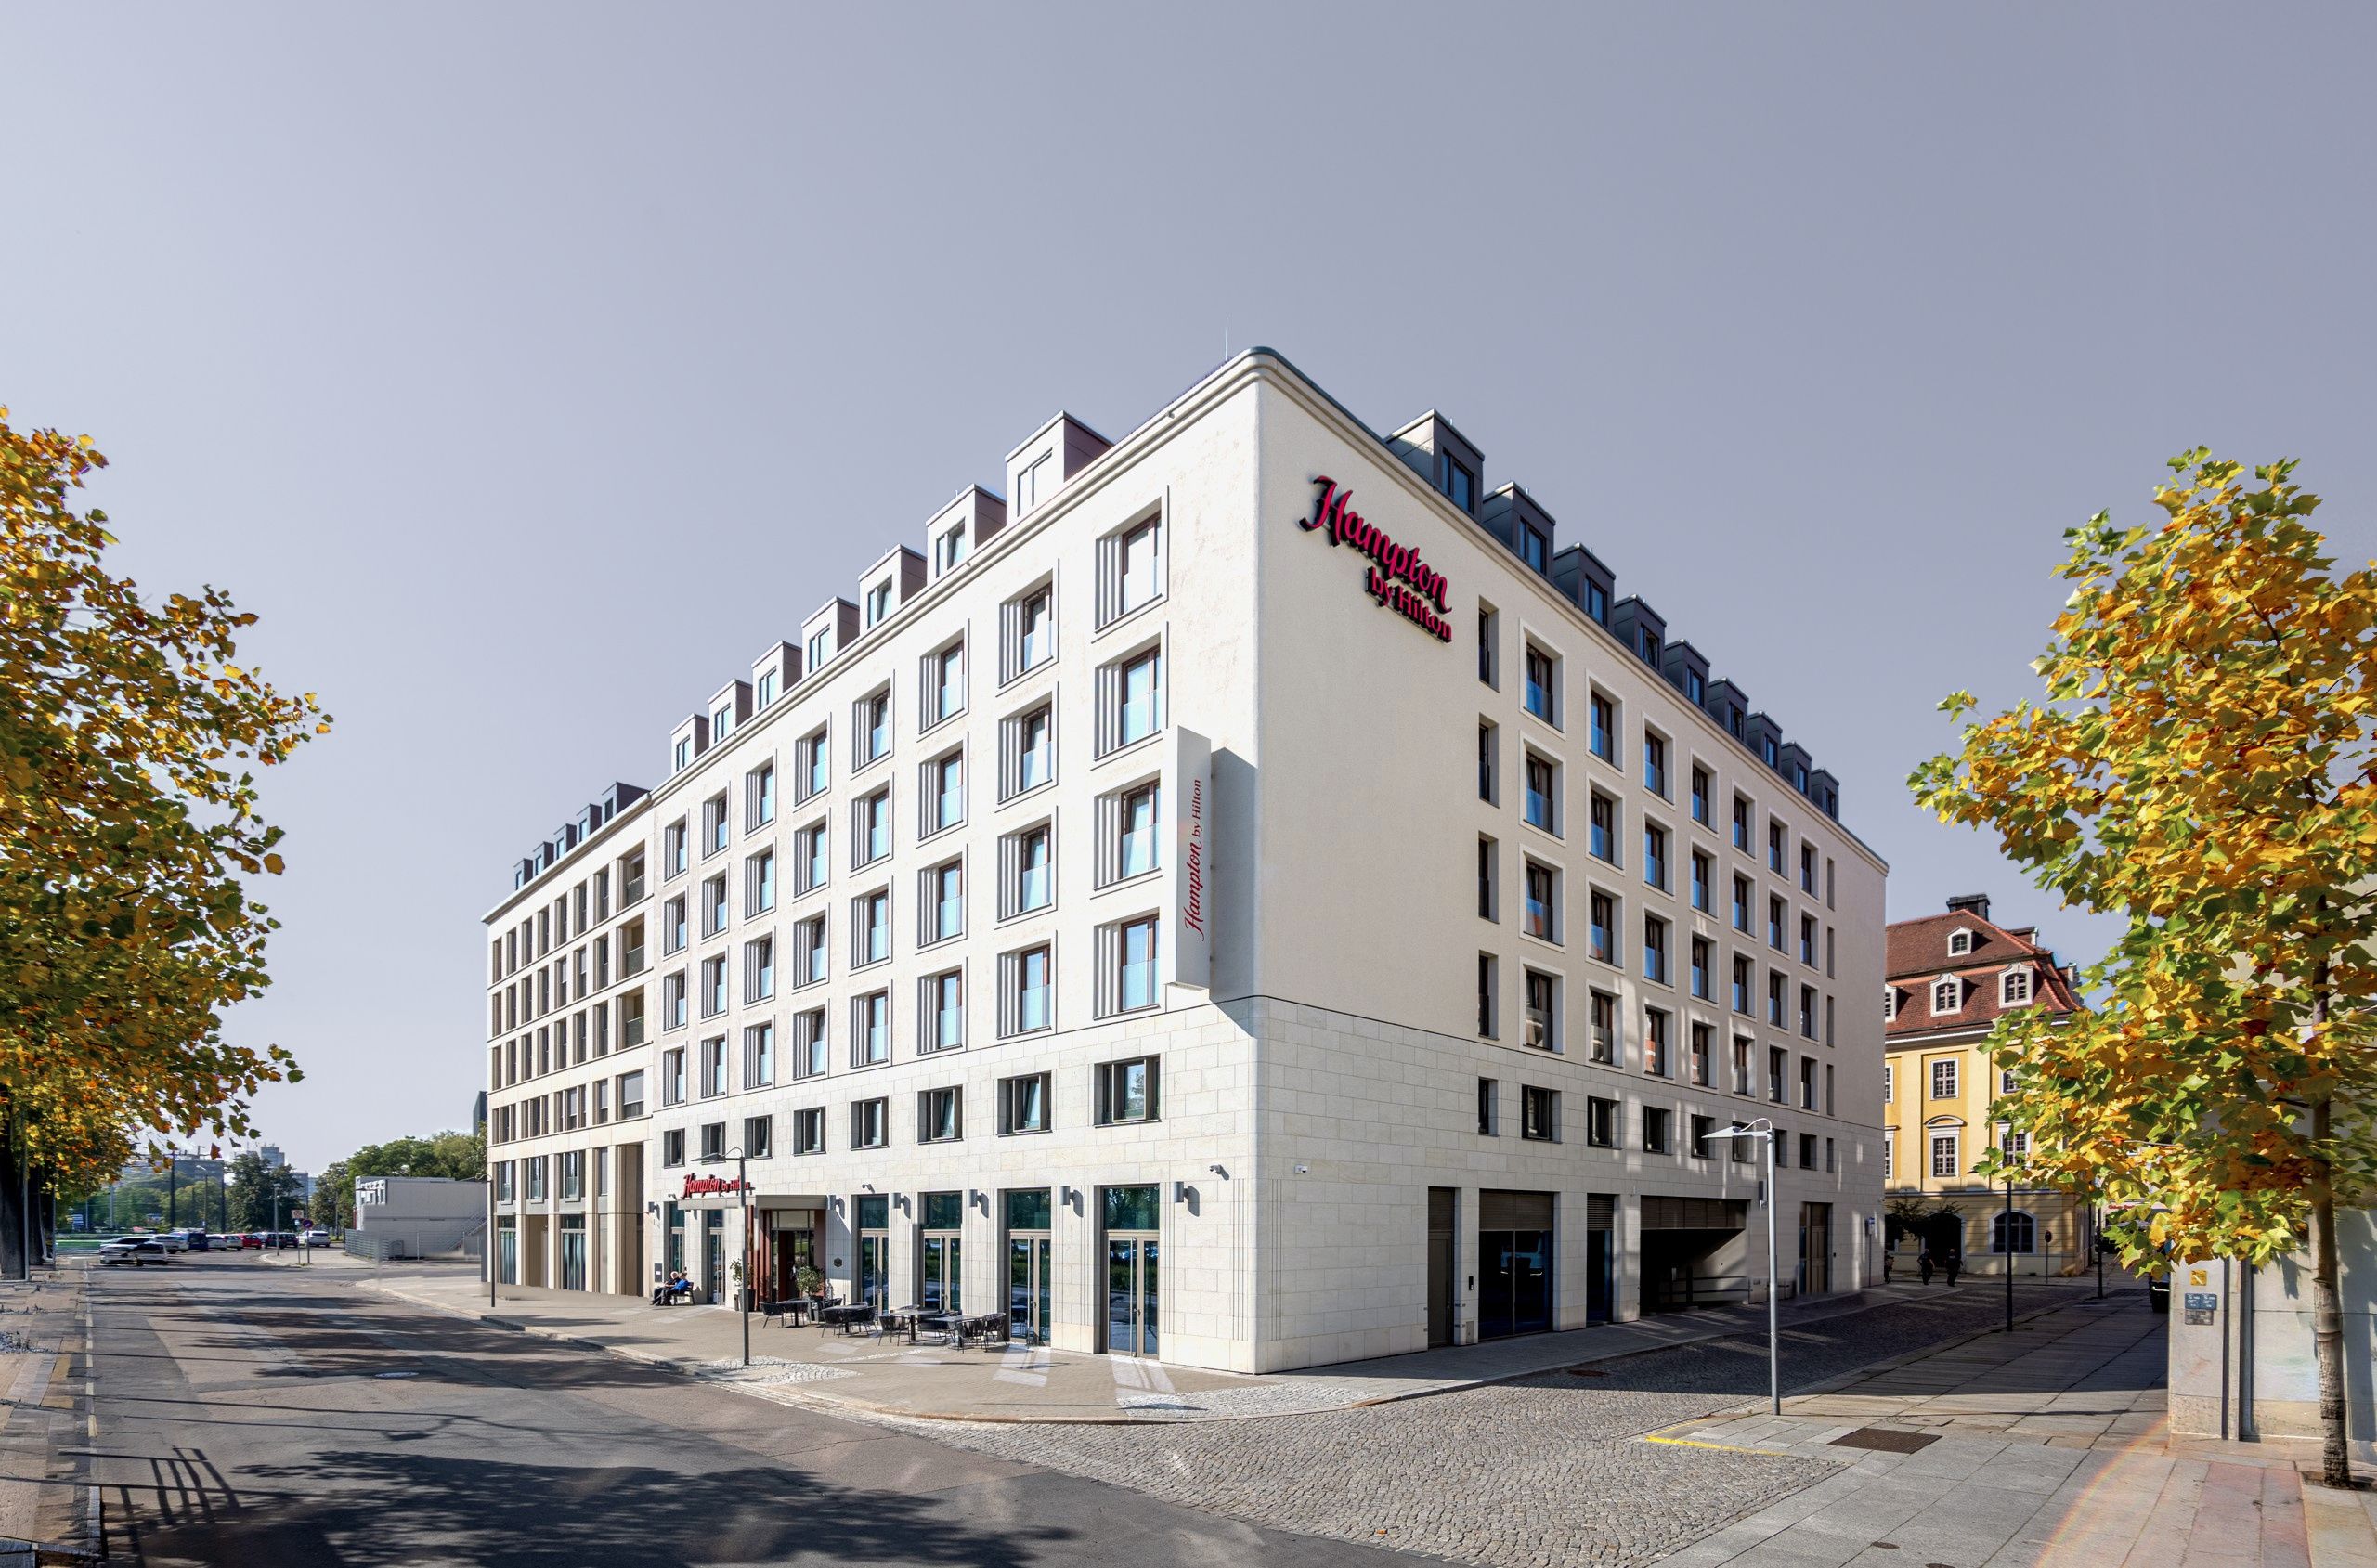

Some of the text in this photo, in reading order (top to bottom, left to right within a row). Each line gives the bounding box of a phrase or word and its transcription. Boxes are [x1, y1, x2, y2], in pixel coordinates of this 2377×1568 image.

[1299, 475, 1453, 614] Hampton
[1366, 566, 1452, 642] by Hilton
[1184, 779, 1203, 941] Hampton by Hilton
[681, 1173, 720, 1199] Hampton
